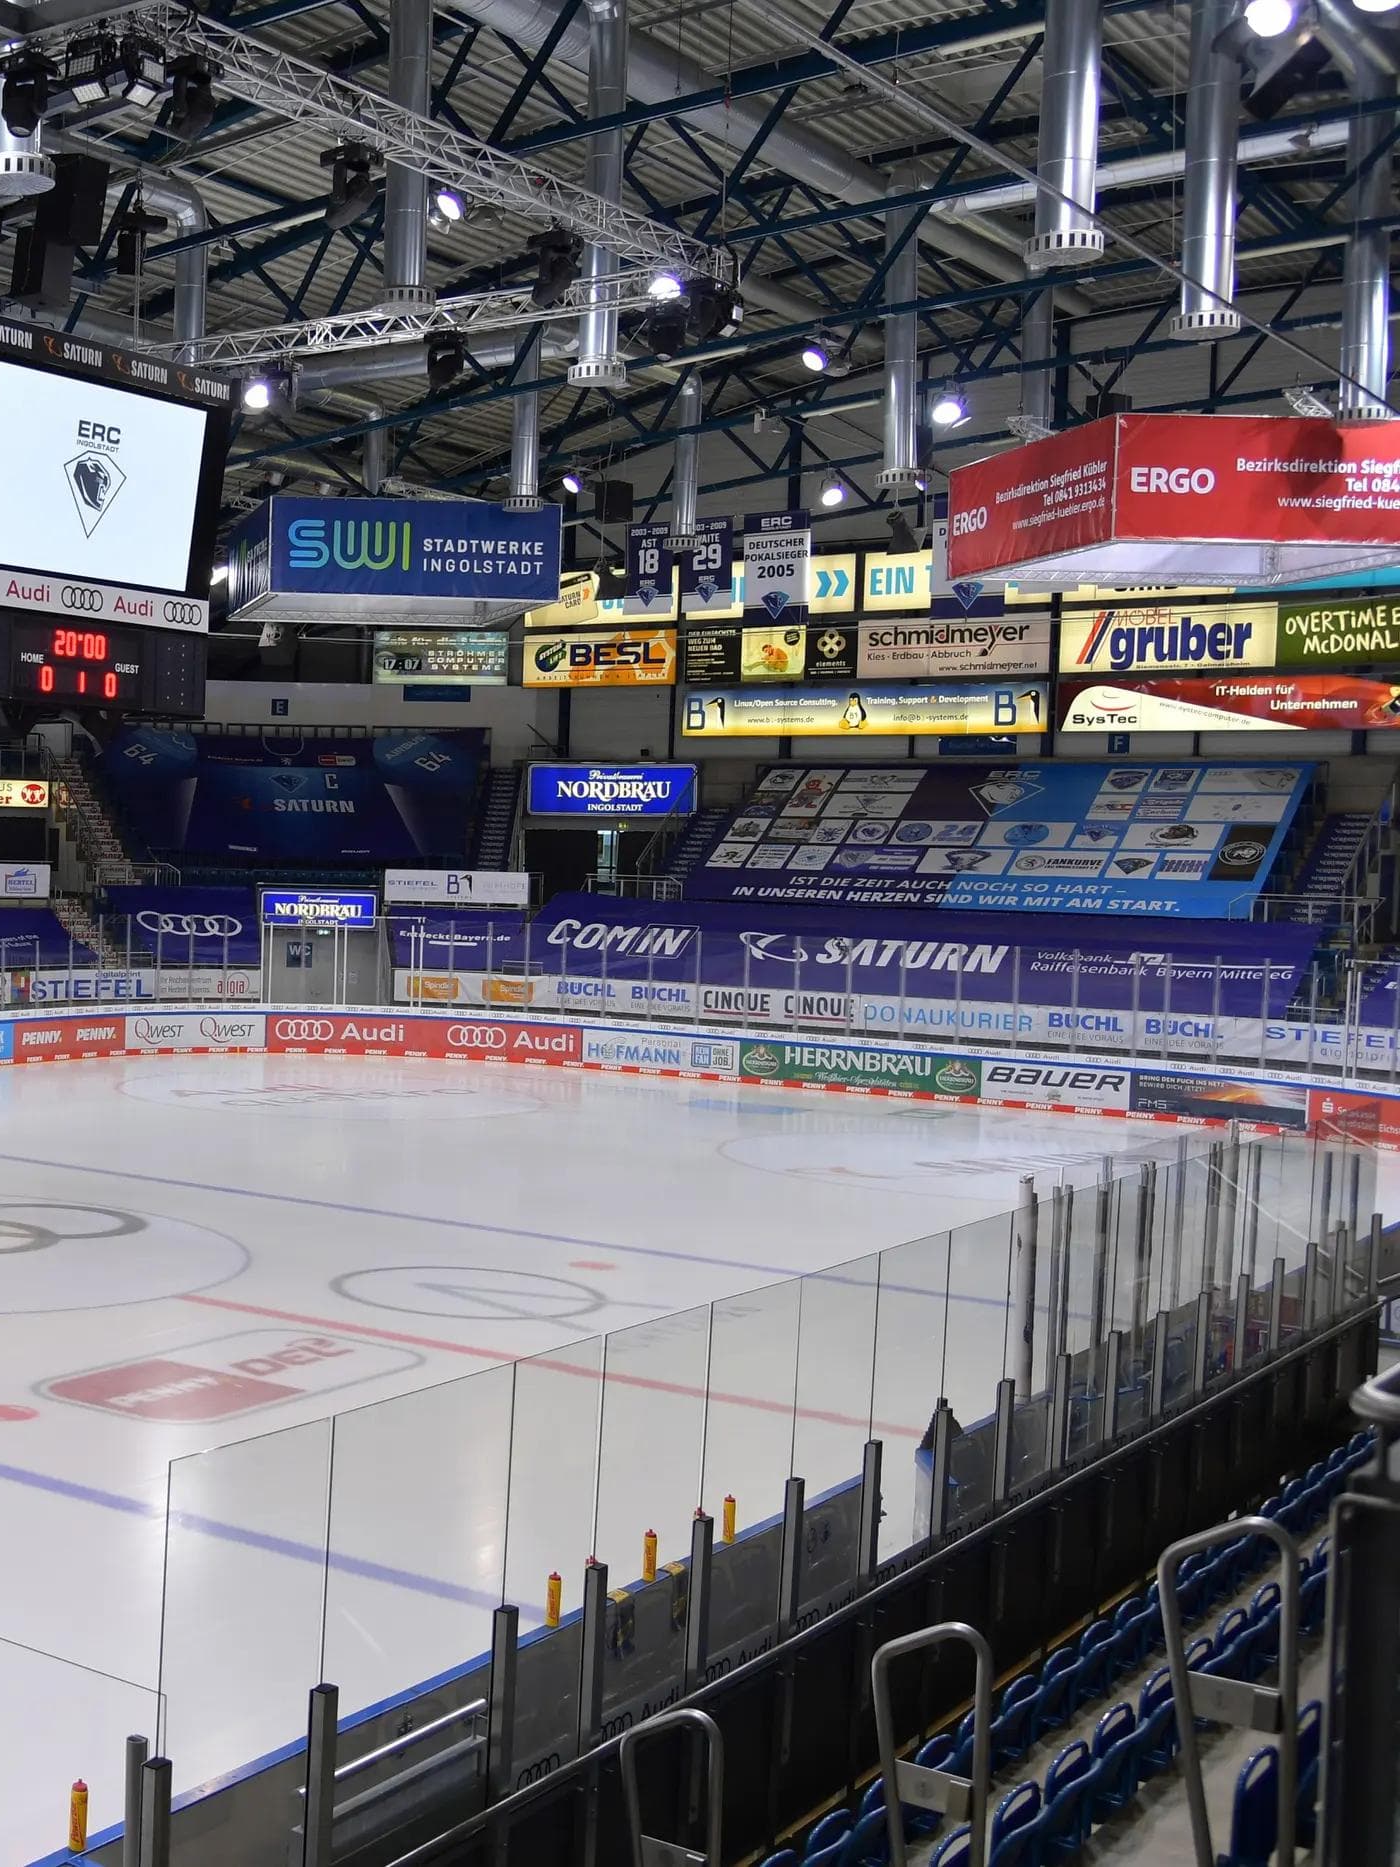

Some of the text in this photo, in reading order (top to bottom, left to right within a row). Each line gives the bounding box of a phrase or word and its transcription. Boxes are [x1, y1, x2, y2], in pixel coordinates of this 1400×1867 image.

[78, 419, 121, 445] ERC
[77, 438, 120, 453] INGOLSTADT
[1050, 467, 1082, 489] Siegfried
[1083, 460, 1107, 476] Kübler
[1237, 458, 1357, 474] Bezirksdirektion
[1130, 467, 1215, 494] ERGO
[1345, 478, 1367, 492] Tel
[1043, 494, 1053, 506] Tel
[1055, 488, 1073, 502] 0841
[761, 516, 792, 527] ERC
[953, 506, 987, 536] ERGO
[423, 539, 543, 556] STADTWERKE
[641, 539, 657, 548] AST
[749, 537, 805, 550] DEUTSCHER
[638, 549, 659, 574] 18
[693, 543, 722, 571] 29
[745, 550, 809, 562] POKALSIEGER
[423, 558, 543, 575] INGOLSTADT
[757, 564, 795, 579] 2005
[870, 564, 914, 596] EIN
[6, 578, 153, 618] Audi Audi
[869, 625, 1030, 651] schmidmeyer
[1110, 617, 1252, 670] gruber
[21, 652, 44, 664] HOME
[570, 642, 666, 666] BESL
[867, 650, 971, 661] Kies Erdbau Abbruch
[115, 663, 139, 674] GUEST
[1216, 684, 1294, 697] IT-Helden für
[899, 695, 928, 705] Support
[939, 695, 988, 704] Development
[1271, 699, 1357, 710] Unternehmen
[1072, 714, 1138, 727] SysTec
[557, 781, 671, 801] NORDBRÄU
[790, 876, 1113, 894] IST DIE ZEIT AUCH NOCH SO HART
[732, 886, 1180, 912] IN UNSEREN HERZEN SIND WIR MIT AM START.
[274, 902, 362, 920] NORDBRÄU
[289, 945, 312, 956] WC
[816, 936, 1008, 974] SATURN
[1219, 969, 1293, 980] Mitte eG
[863, 1002, 1033, 1032] DONAUKURIER
[340, 1021, 574, 1053] Audi Audi
[712, 1048, 729, 1057] OHNE
[784, 1046, 931, 1076] HERRNBRÄU
